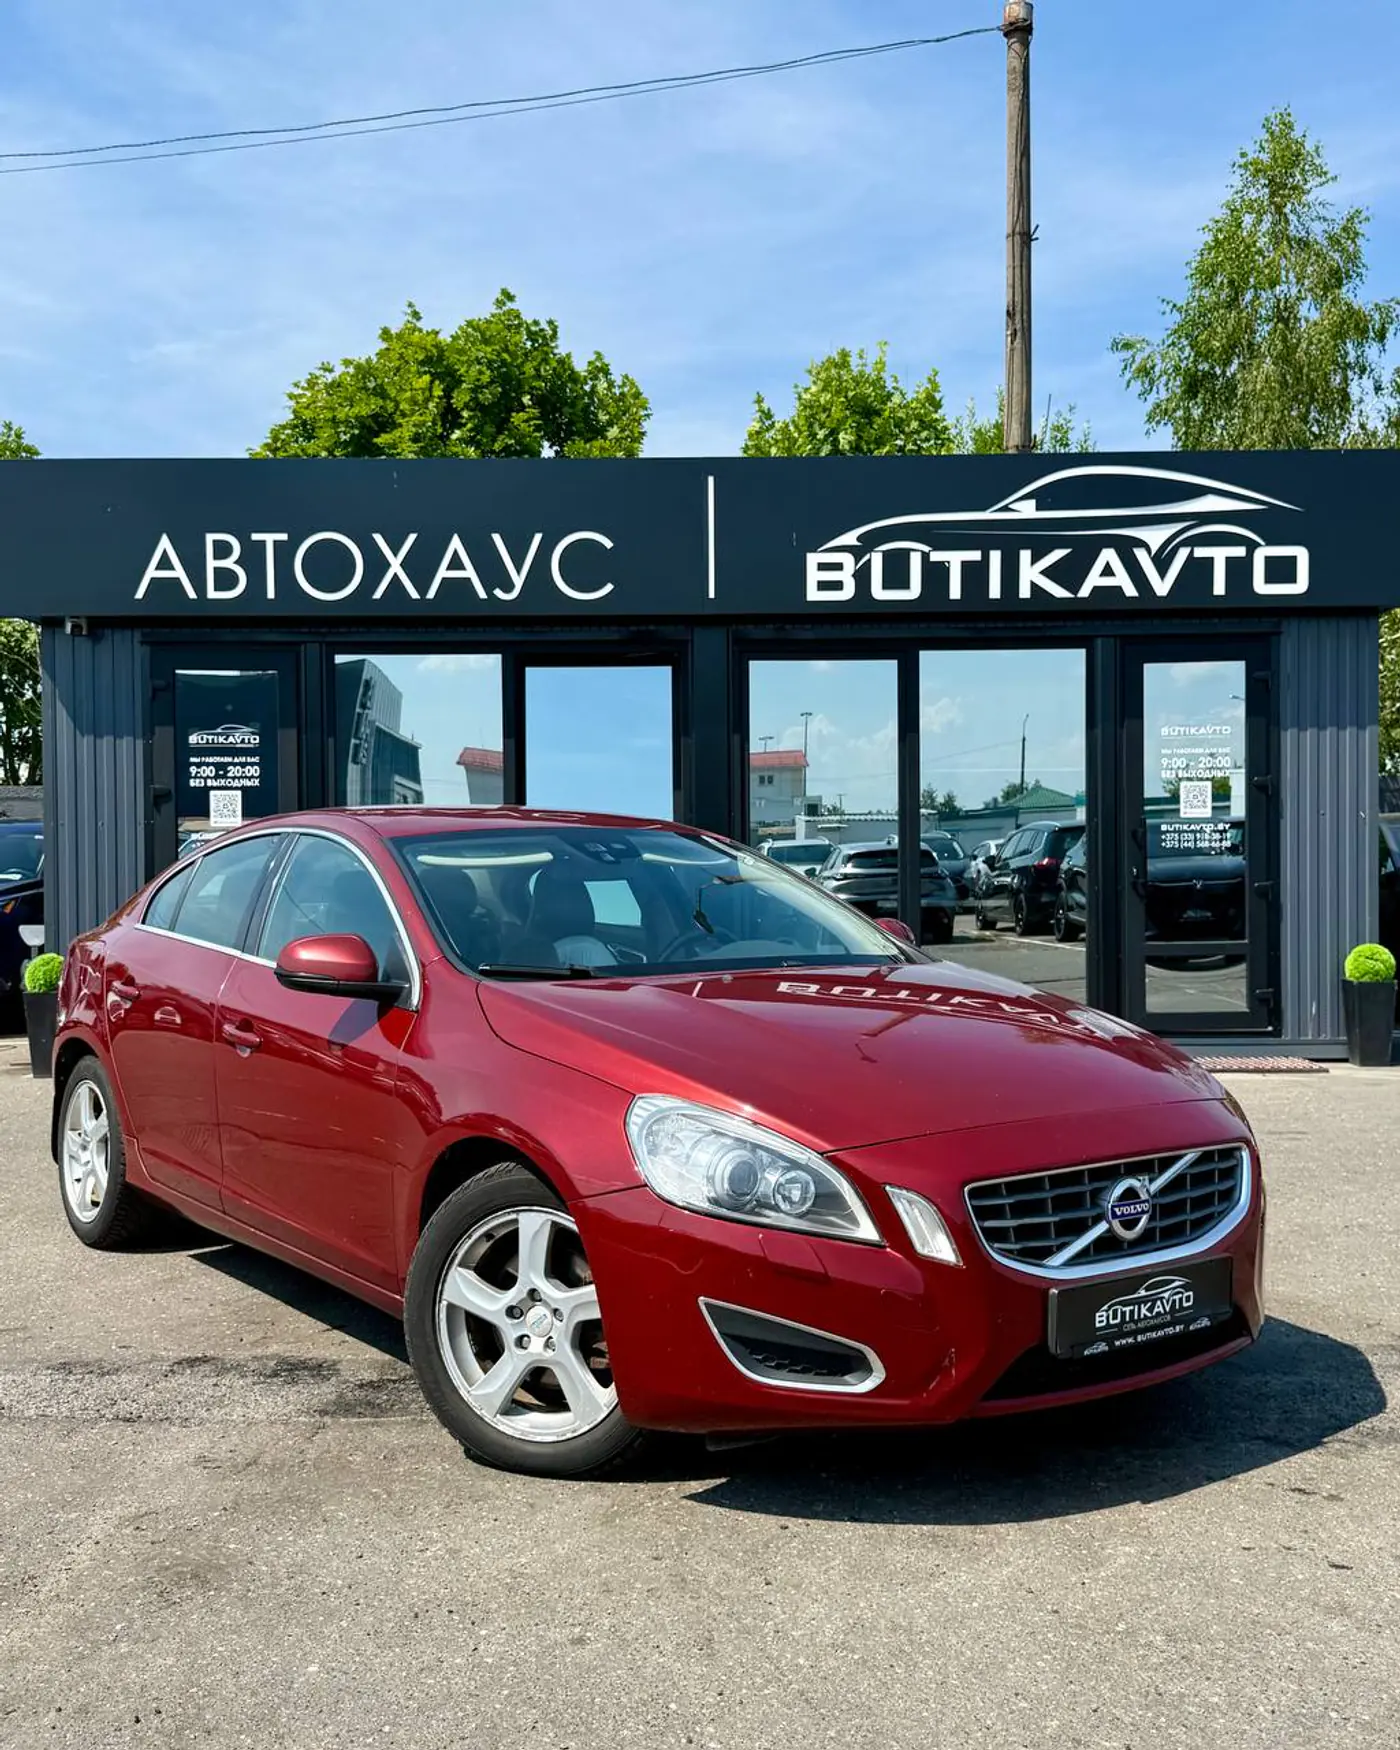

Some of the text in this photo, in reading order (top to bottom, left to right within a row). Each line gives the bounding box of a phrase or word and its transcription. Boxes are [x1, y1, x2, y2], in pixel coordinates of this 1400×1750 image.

[134, 531, 615, 601] АВТОХАУС
[806, 545, 1310, 602] BUTIKAVTO
[1160, 725, 1232, 735] BUTIKAVTO
[188, 735, 260, 744] BUTIKAVTO
[1161, 757, 1187, 768] 9:00
[1198, 756, 1231, 768] 20:00
[189, 765, 216, 777] 9:00
[226, 765, 260, 777] 20:00
[1178, 768, 1230, 778] ВЫХОДНЫХ
[206, 778, 260, 788] ВЫХОДНЫХ
[1113, 1203, 1150, 1216] VOLVO
[1095, 1291, 1194, 1328] BUTIKAVTO
